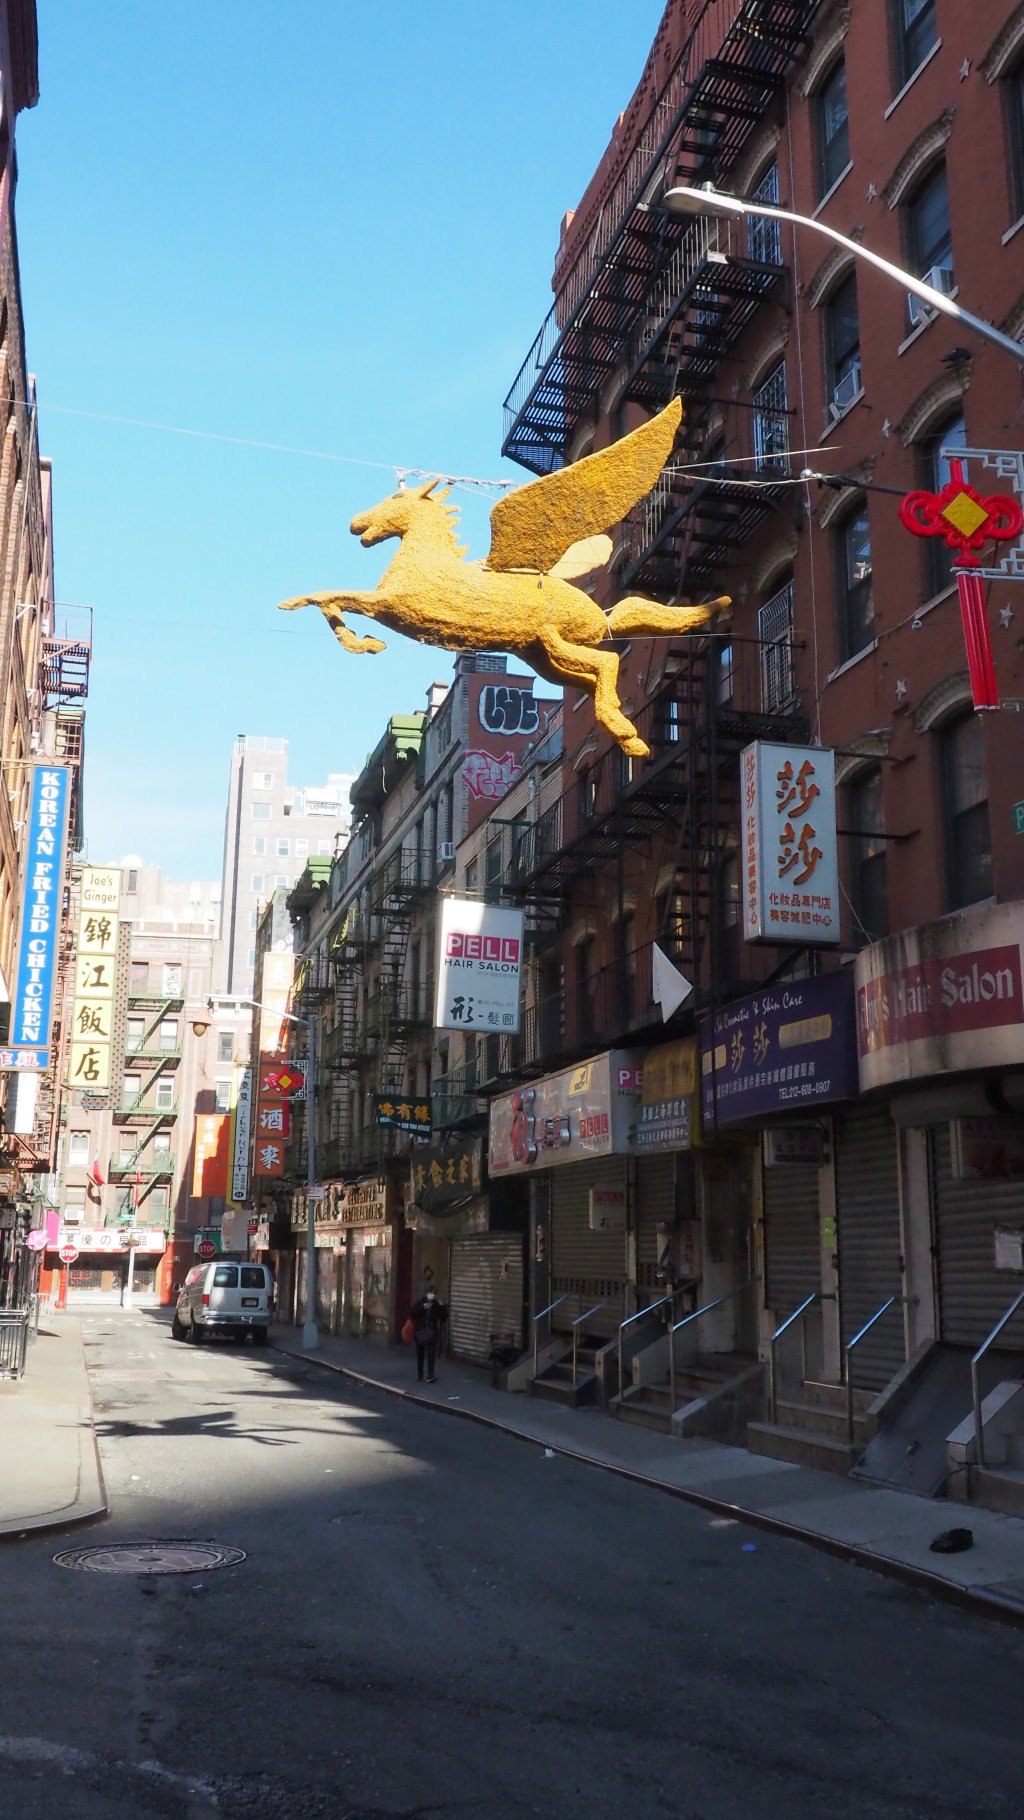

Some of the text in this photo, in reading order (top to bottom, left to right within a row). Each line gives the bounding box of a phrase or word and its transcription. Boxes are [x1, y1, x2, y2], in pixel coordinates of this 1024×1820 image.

[91, 874, 113, 886] Joe's
[21, 772, 60, 1042] KOREAN FRIED CHICKEN
[84, 889, 117, 904] Ginger
[448, 935, 516, 960] PELL
[445, 959, 519, 973] HAIR SALON
[941, 963, 1014, 1007] Salon
[75, 916, 112, 1081] 錦江飯店
[762, 997, 780, 1015] Skin
[783, 992, 803, 1009] Care
[581, 1114, 608, 1138] PELL
[61, 1249, 77, 1257] STOP
